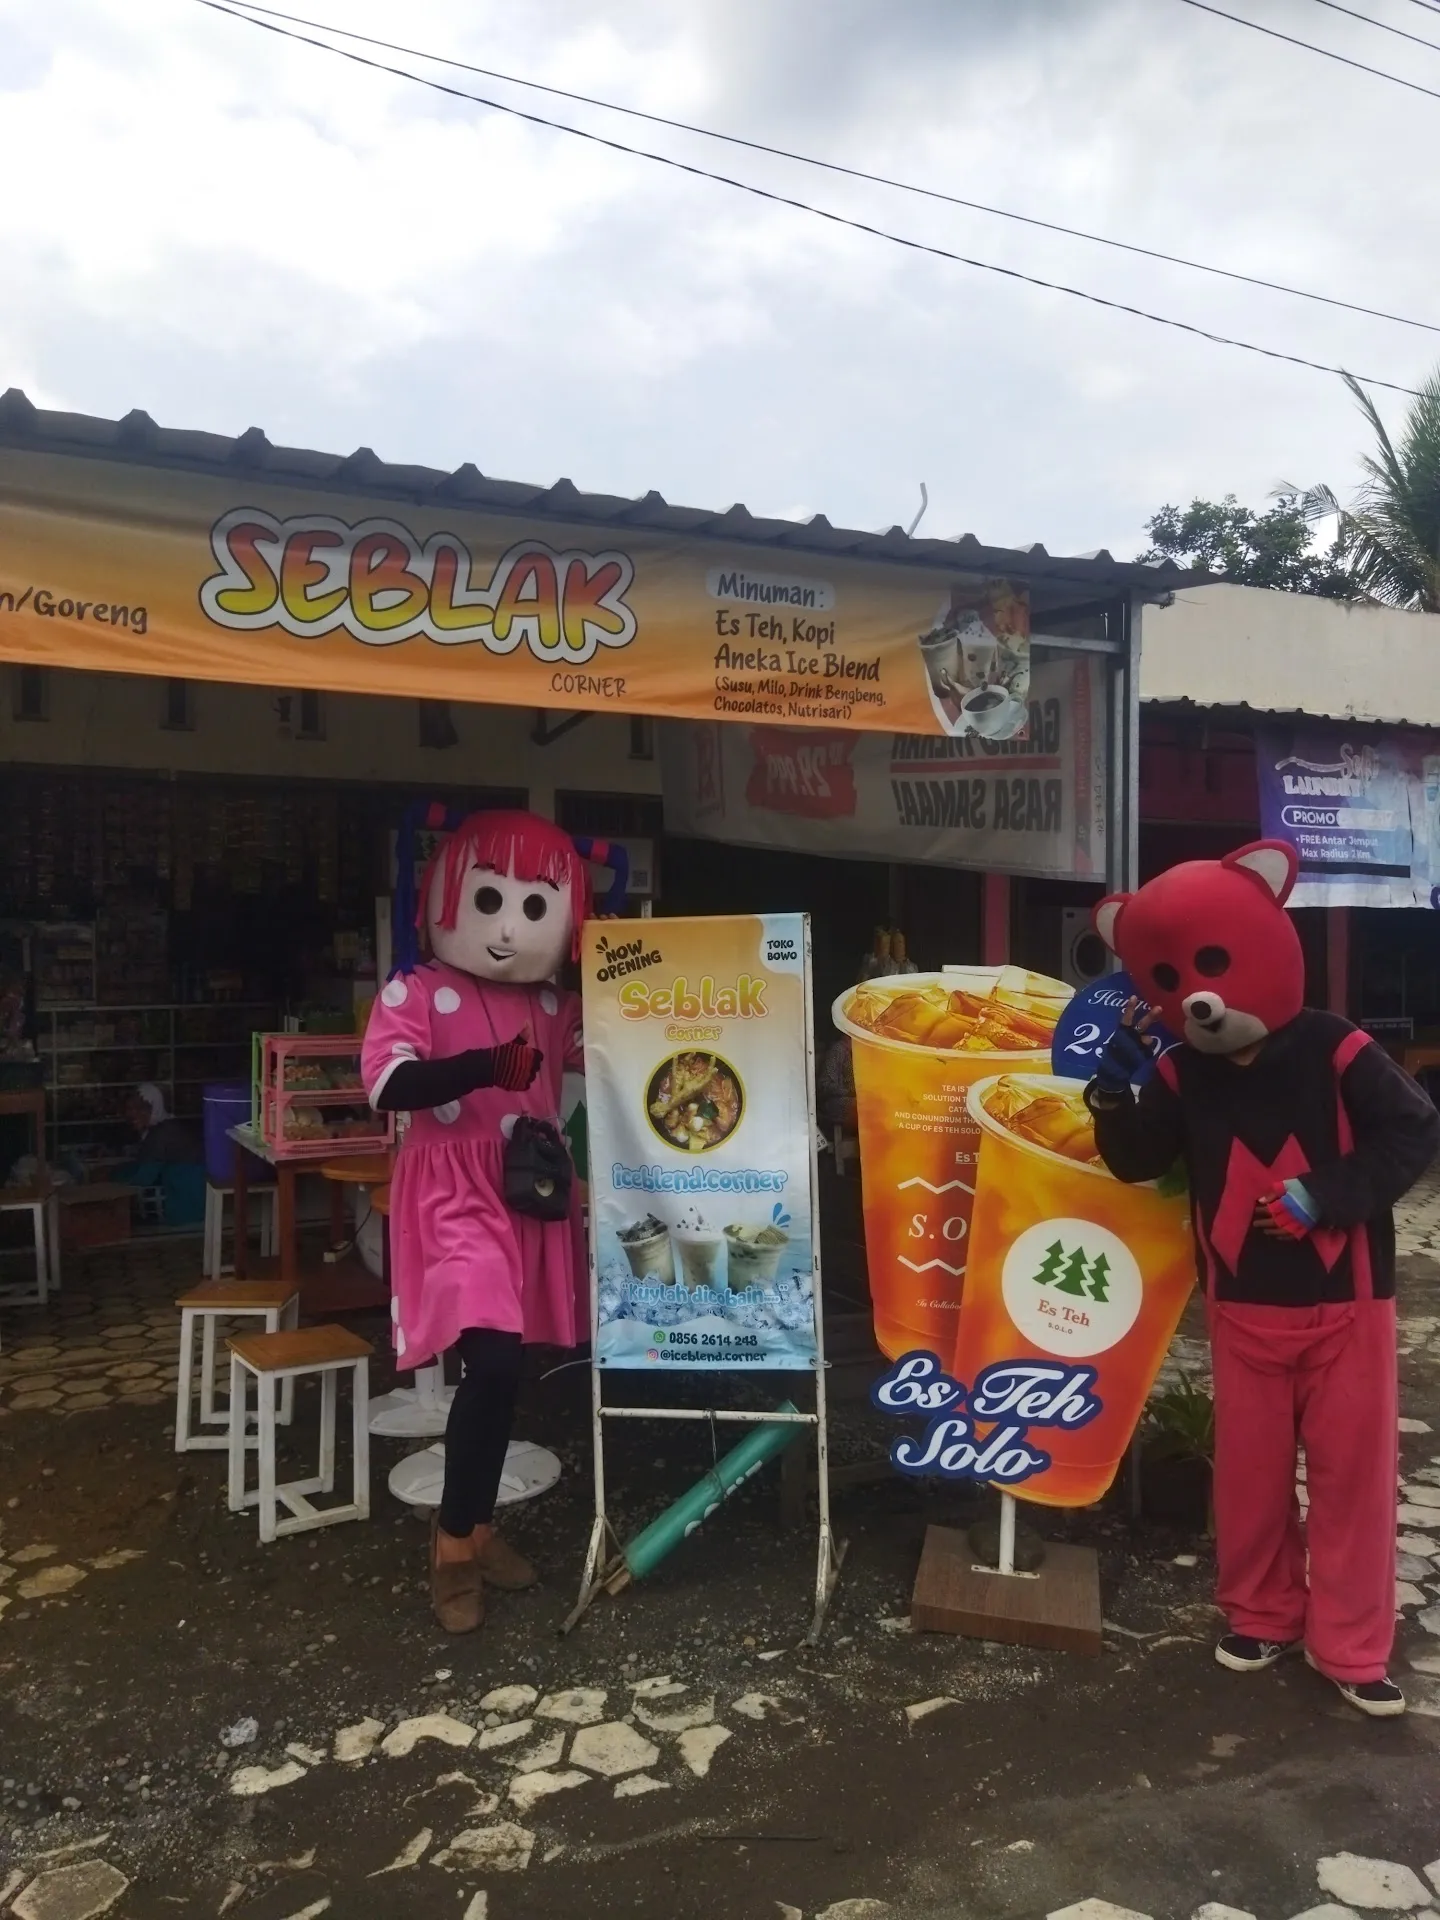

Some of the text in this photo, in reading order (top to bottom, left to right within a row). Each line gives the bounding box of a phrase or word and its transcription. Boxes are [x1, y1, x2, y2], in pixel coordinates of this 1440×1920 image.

[206, 514, 632, 658] SEBLAK
[716, 610, 835, 650] Es Teh, Kopi
[714, 643, 881, 682] Aneka Ice Blend
[715, 676, 756, 695] (Susu,
[757, 679, 787, 697] Milo,
[789, 682, 822, 699] Drink
[714, 696, 852, 720] Chocolatos, Nutrisari)
[1293, 811, 1336, 825] PROMO
[1300, 834, 1321, 845] FREE
[1322, 835, 1346, 846] Antar
[1301, 848, 1318, 858] Max
[1320, 848, 1349, 859] Radius
[605, 939, 643, 964] NOW
[766, 939, 795, 950] TOKO
[767, 951, 797, 961] BOWO
[596, 949, 663, 983] OPENING
[618, 973, 768, 1022] Seblak
[665, 1023, 723, 1041] Corner
[942, 1084, 956, 1092] TEA
[957, 1085, 965, 1093] IS
[922, 1093, 961, 1103] SOLUTION
[895, 1111, 911, 1119] AND
[911, 1113, 962, 1124] CONUNDRUM
[905, 1123, 921, 1131] CUP
[922, 1124, 933, 1132] OF
[933, 1125, 943, 1133] ES
[945, 1126, 960, 1134] TEH
[960, 1127, 981, 1135] SOLO
[955, 1151, 971, 1163] Es
[612, 1162, 789, 1193] iceblend.corner
[1037, 1298, 1091, 1328] Es Teh
[669, 1332, 758, 1346] 0856 2614 248
[660, 1349, 768, 1363] @iceblend.corner
[878, 1357, 1095, 1422] Es Teh
[895, 1419, 1044, 1477] Solo
